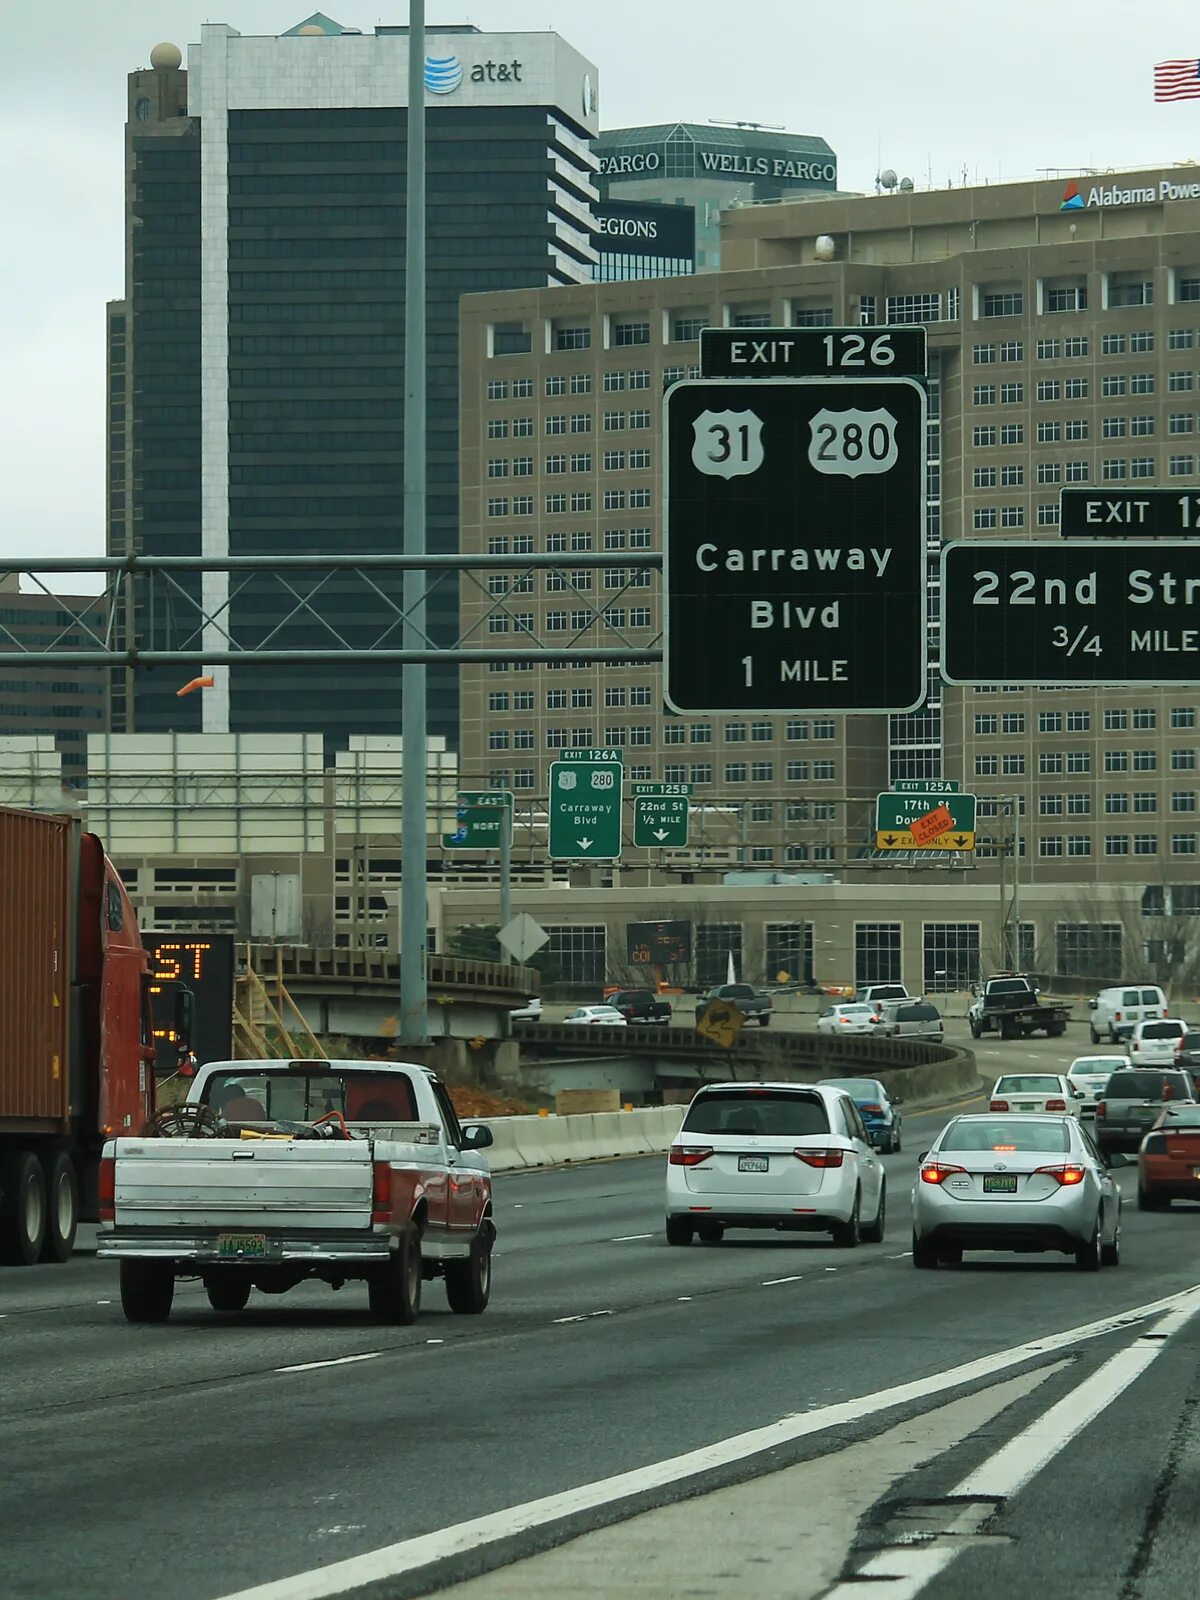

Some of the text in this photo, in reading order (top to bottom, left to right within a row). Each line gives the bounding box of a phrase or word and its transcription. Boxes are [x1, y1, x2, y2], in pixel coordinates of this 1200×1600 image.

[470, 59, 522, 83] at&t
[597, 152, 660, 175] FARGO
[701, 152, 837, 182] WELLS FARGO
[1087, 185, 1156, 208] Alabama
[596, 216, 658, 239] EGIONS
[730, 334, 896, 366] EXIT 126
[706, 422, 890, 462] 31 280
[1085, 501, 1150, 523] EXIT
[695, 543, 892, 577] Carraway
[972, 571, 1097, 605] 22nd
[750, 600, 840, 628] Blvd
[1130, 630, 1199, 651] MILE
[741, 655, 848, 687] 1 MILE
[564, 750, 618, 760] EXIT 126A
[592, 774, 612, 786] 280
[636, 784, 688, 794] EXIT 125B
[901, 781, 952, 792] EXIT 125A
[560, 803, 612, 813] Carraway
[640, 802, 684, 811] 22nd St
[904, 800, 930, 810] 17th
[472, 822, 500, 831] NORT
[574, 816, 597, 825] Blvd
[918, 819, 949, 841] CLOSED
[921, 814, 939, 830] EXIT
